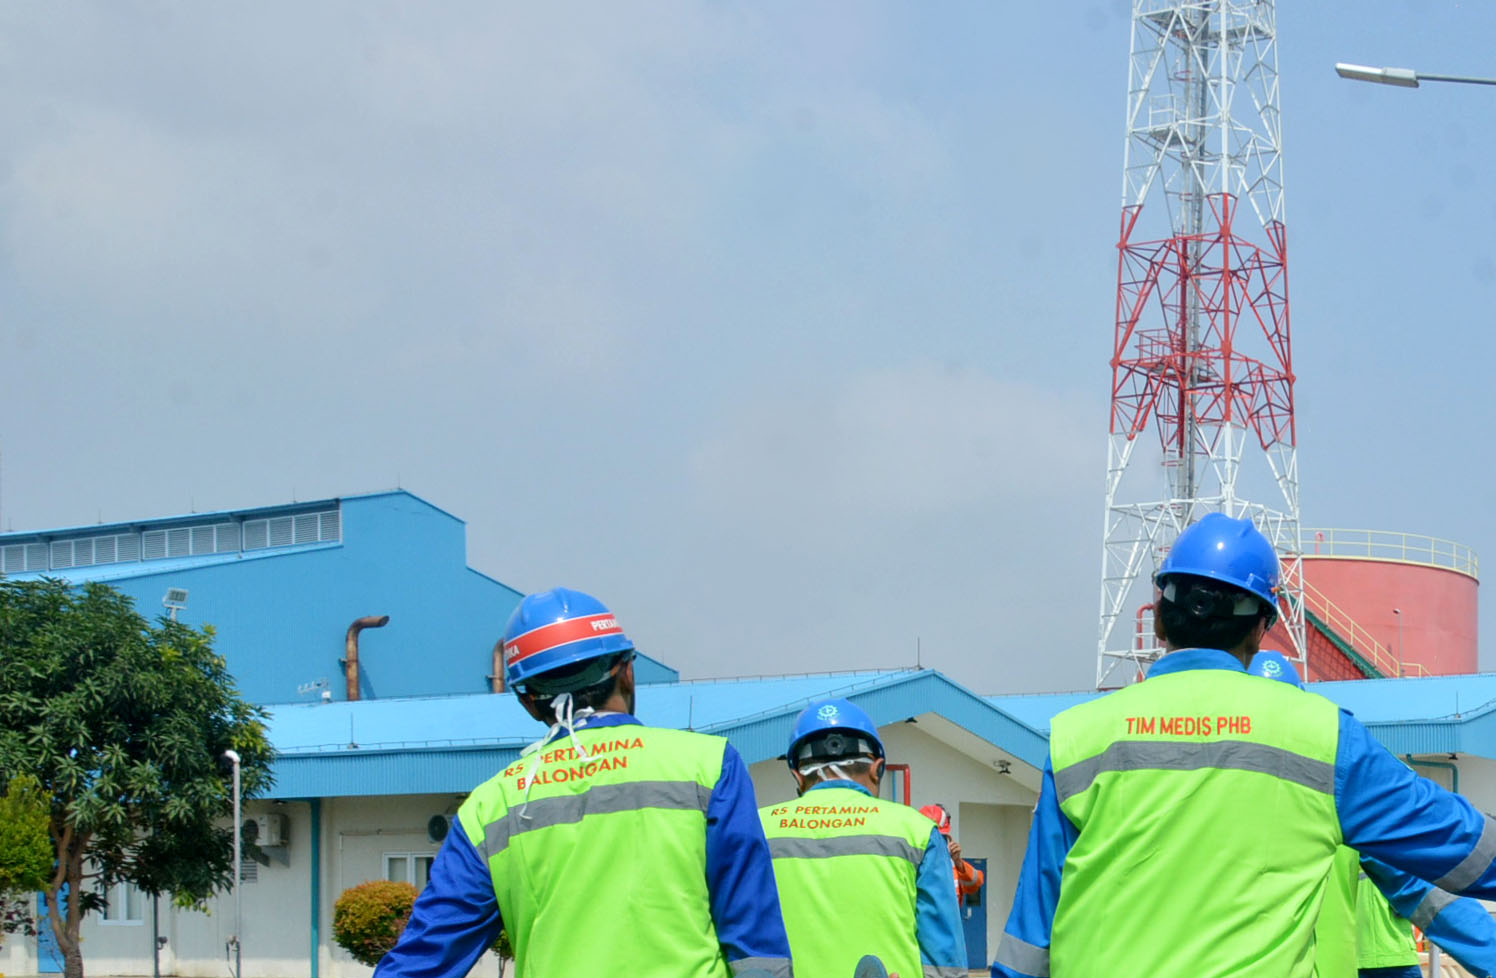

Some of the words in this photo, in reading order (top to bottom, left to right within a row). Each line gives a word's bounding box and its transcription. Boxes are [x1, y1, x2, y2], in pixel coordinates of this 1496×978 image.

[1126, 716, 1155, 735] TIM
[1160, 716, 1212, 736] MEDIS
[1217, 716, 1252, 735] PHB
[503, 763, 525, 778] RS
[517, 756, 628, 790] BALONGAN
[771, 806, 789, 816] RS
[795, 805, 880, 815] PERTAMINA
[779, 816, 866, 829] BALONGAN
